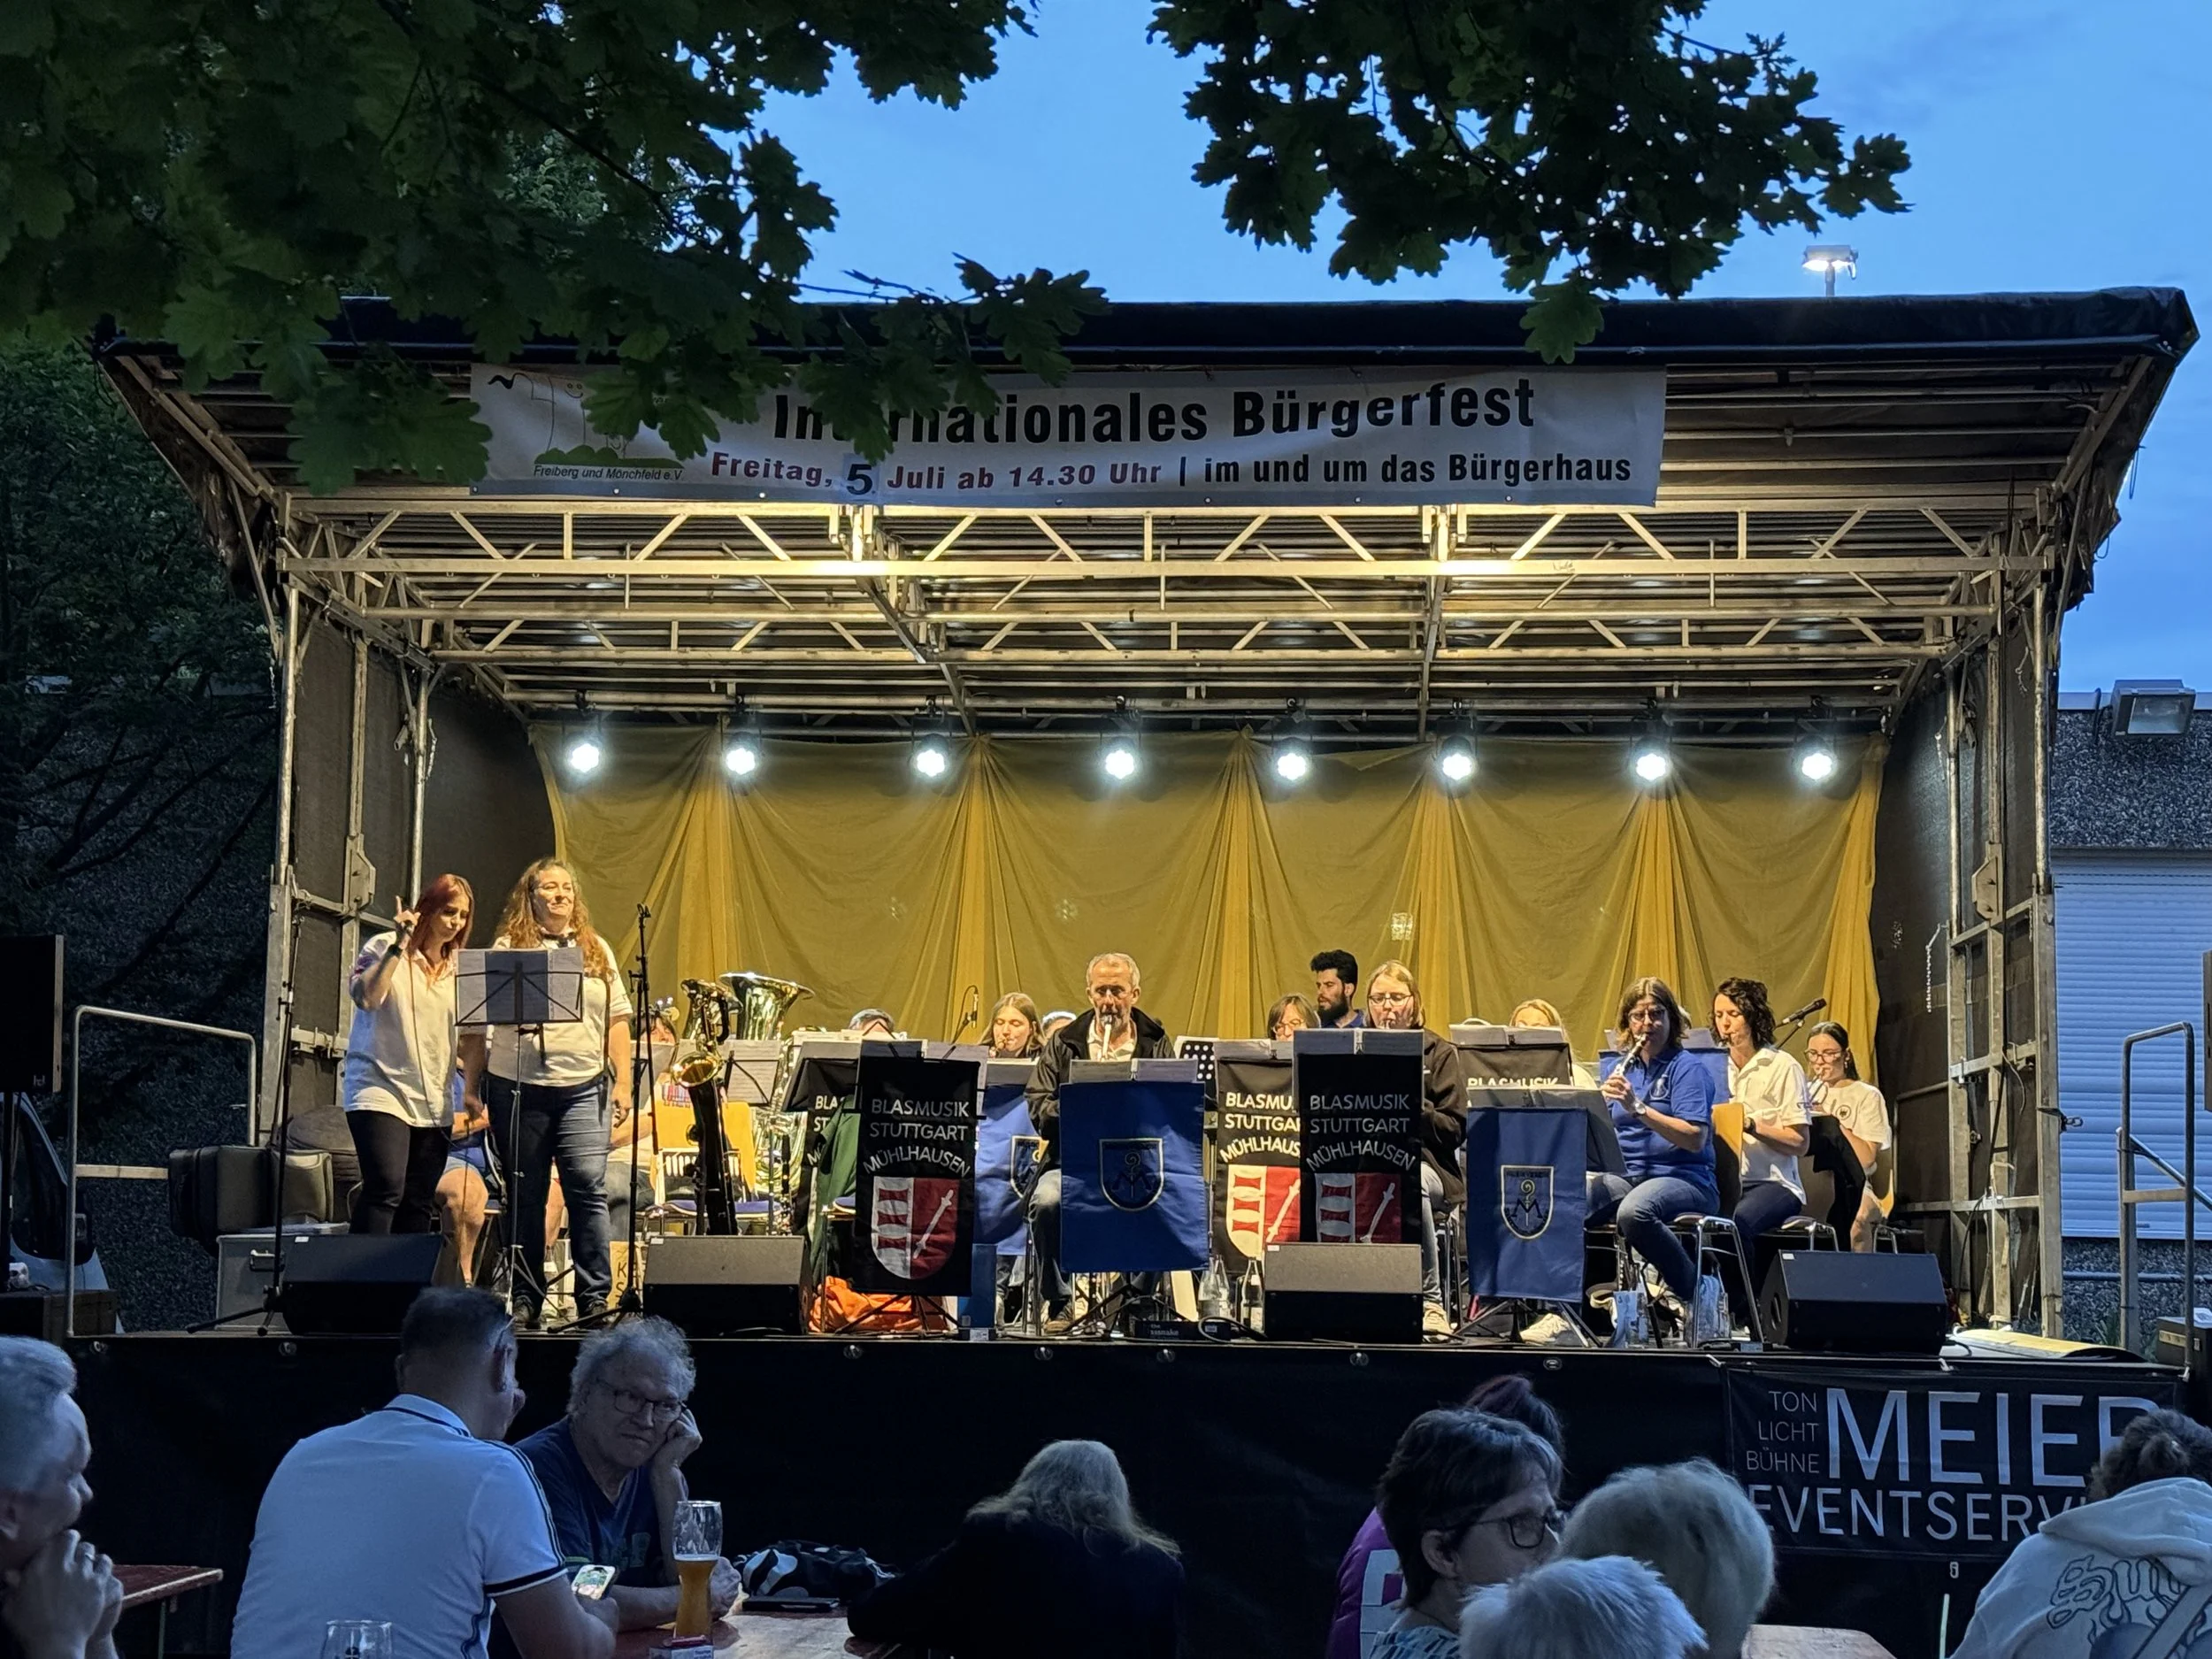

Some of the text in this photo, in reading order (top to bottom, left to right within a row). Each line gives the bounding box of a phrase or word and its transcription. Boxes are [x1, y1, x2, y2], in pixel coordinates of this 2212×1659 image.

[1233, 379, 1534, 438] Bürgerfest
[534, 465, 579, 480] Freiberg
[581, 467, 603, 479] und
[711, 451, 833, 488] Freitag,
[887, 465, 945, 488] Juli
[957, 467, 995, 489] ab
[1009, 465, 1095, 488] 14.30
[1110, 462, 1162, 484] Uhr
[1204, 457, 1240, 483] im
[1254, 454, 1310, 483] und
[1324, 460, 1367, 483] um
[1381, 454, 1436, 483] das
[1449, 453, 1631, 487] Bürgerhaus
[872, 1099, 970, 1118] BLASMUSIK
[1225, 1092, 1294, 1110] BLASMU
[1310, 1094, 1410, 1110] BLASMUSIK
[870, 1122, 968, 1141] STUTTGART
[1310, 1118, 1410, 1133] STUTTGART
[863, 1145, 971, 1178] MÜHLHAUSEN
[1306, 1140, 1416, 1171] MÜHLHAUSEN
[1768, 1390, 1817, 1412] TON
[1758, 1420, 1819, 1441] LICHT
[1746, 1446, 1820, 1474] BÜHNE
